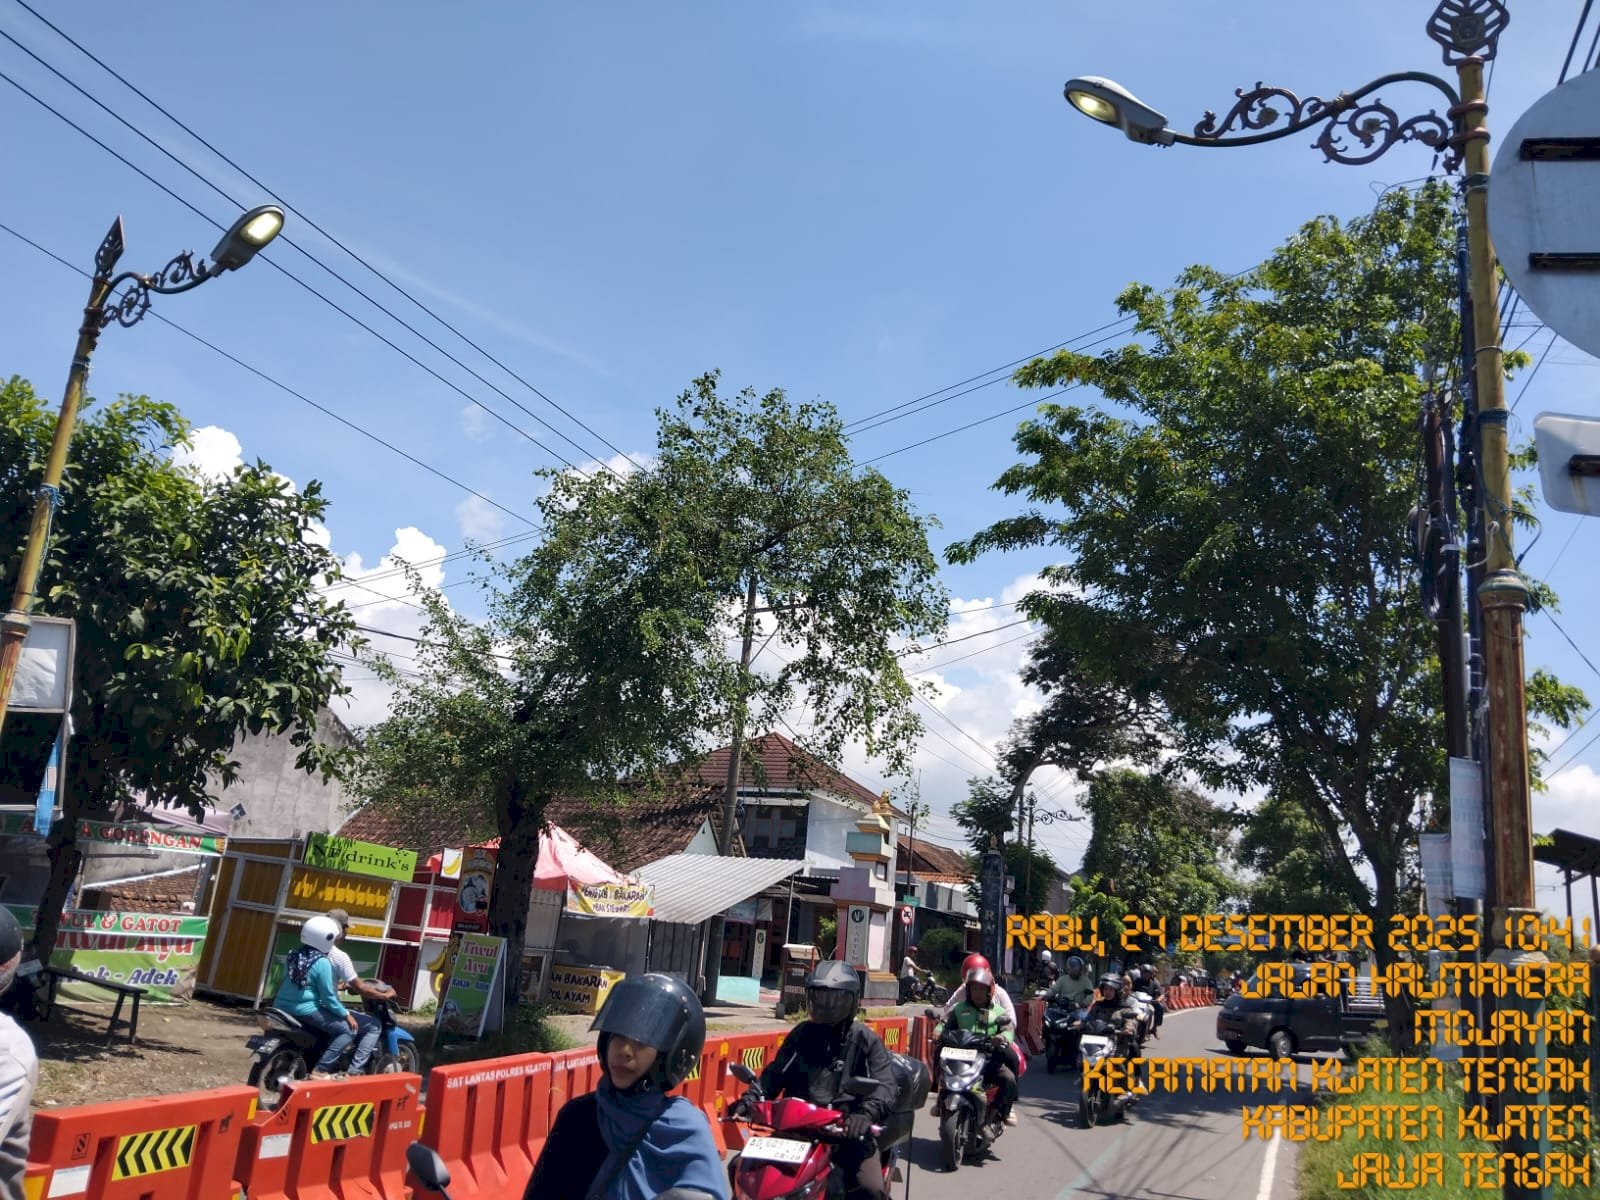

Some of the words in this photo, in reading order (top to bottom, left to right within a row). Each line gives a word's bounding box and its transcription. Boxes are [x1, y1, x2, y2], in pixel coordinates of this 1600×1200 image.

[99, 824, 202, 849] GORENGAN
[345, 851, 410, 871] drink's
[101, 913, 117, 930] &
[121, 919, 182, 932] GATOT
[463, 940, 498, 958] Tiwul
[126, 968, 179, 986] Adek
[564, 972, 608, 989] BAKARAN
[563, 992, 591, 1004] AYAM
[447, 1077, 464, 1089] SAT
[465, 1071, 496, 1085] LANTAS
[496, 1066, 524, 1080] POLRES
[525, 1062, 552, 1076] KLATEN
